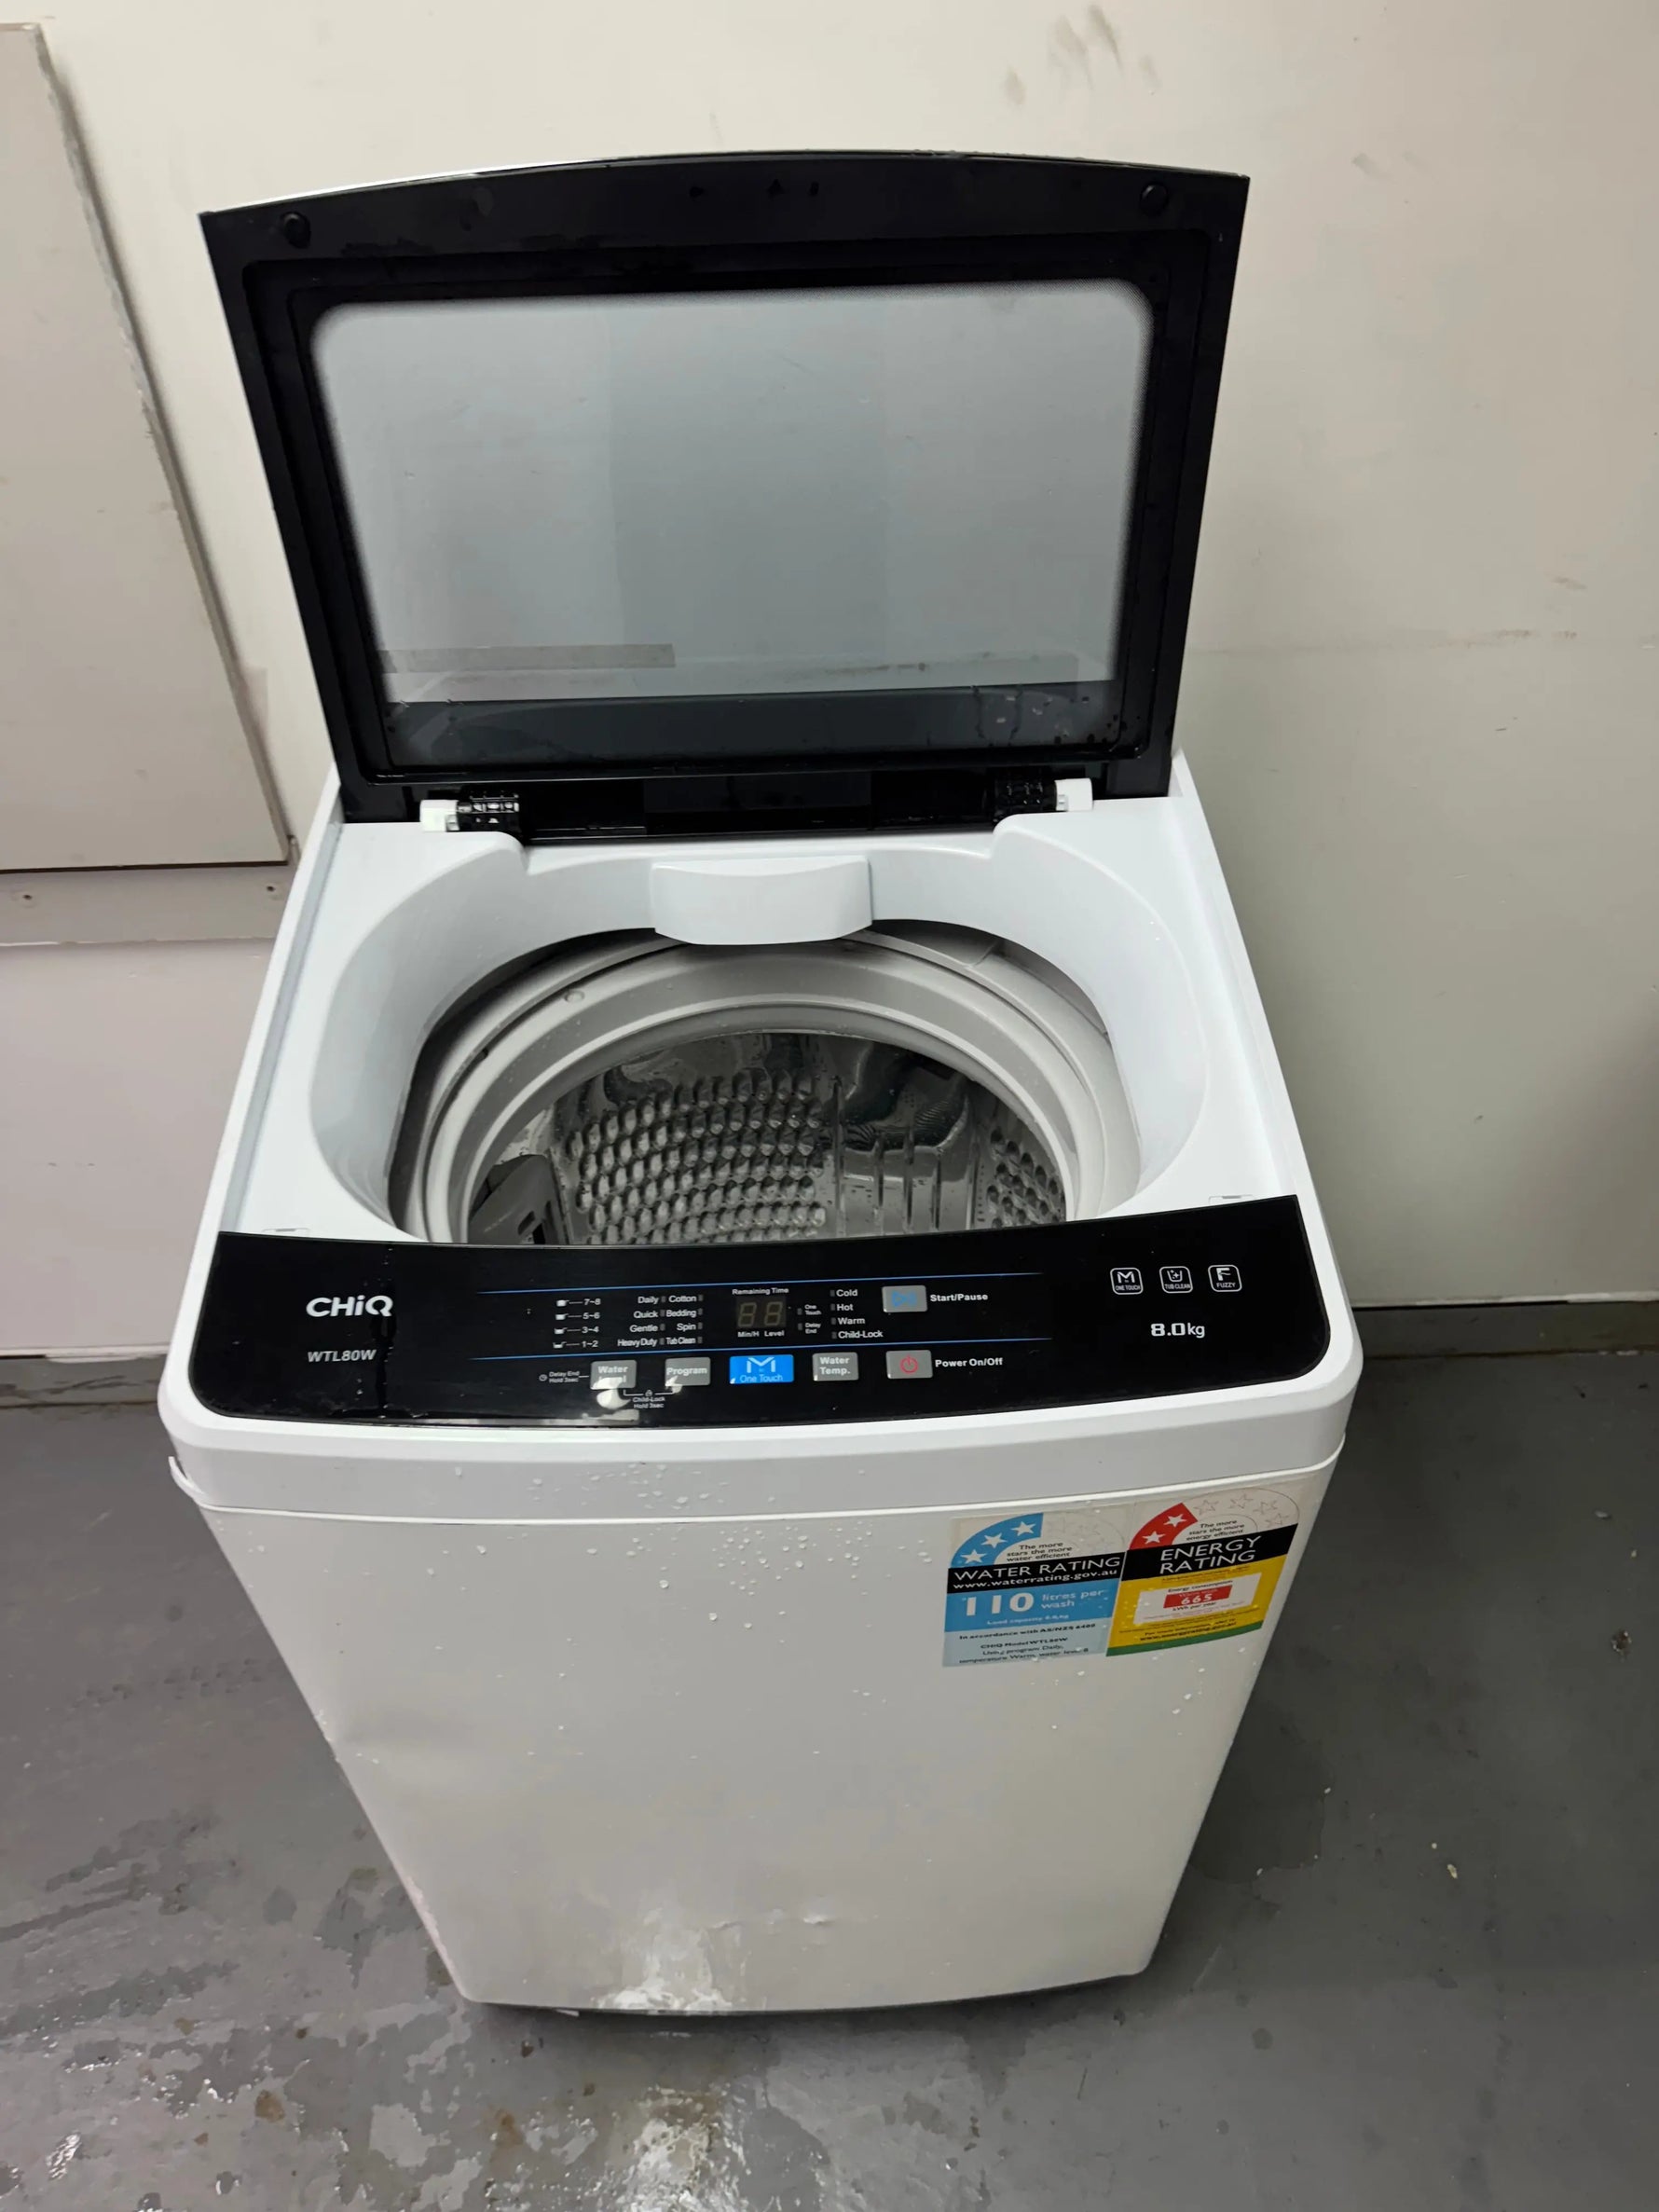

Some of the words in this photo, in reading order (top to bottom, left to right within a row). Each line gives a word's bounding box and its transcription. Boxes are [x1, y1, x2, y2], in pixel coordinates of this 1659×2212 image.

[638, 1296, 659, 1305] Daily
[930, 1293, 988, 1302] Start/Pause
[306, 1295, 393, 1317] CHiQ
[665, 1309, 697, 1318] Bedding
[629, 1325, 658, 1333] Gentle
[677, 1323, 696, 1331] Spin
[1150, 1323, 1205, 1339] 8.0kg
[838, 1330, 884, 1339] Child-Lock
[617, 1339, 640, 1348] Heavy
[308, 1350, 377, 1363] WTL80W
[969, 1357, 1003, 1367] On/Off
[598, 1366, 628, 1374] Water
[666, 1367, 707, 1376] Program
[820, 1367, 850, 1376] Temp.
[740, 1374, 757, 1382] One
[759, 1374, 783, 1382] Touch
[1160, 1536, 1262, 1560] ENERGY
[1035, 1552, 1071, 1560] efficient
[1159, 1549, 1256, 1574] RATING
[953, 1566, 1031, 1581] WATER
[1039, 1557, 1120, 1573] RATING
[953, 1569, 1117, 1589] www.waterrating.gov.au
[1042, 1592, 1076, 1601] litres
[1080, 1589, 1104, 1600] per
[1180, 1594, 1213, 1605] 665
[966, 1592, 1035, 1616] 110
[1041, 1600, 1075, 1609] wash
